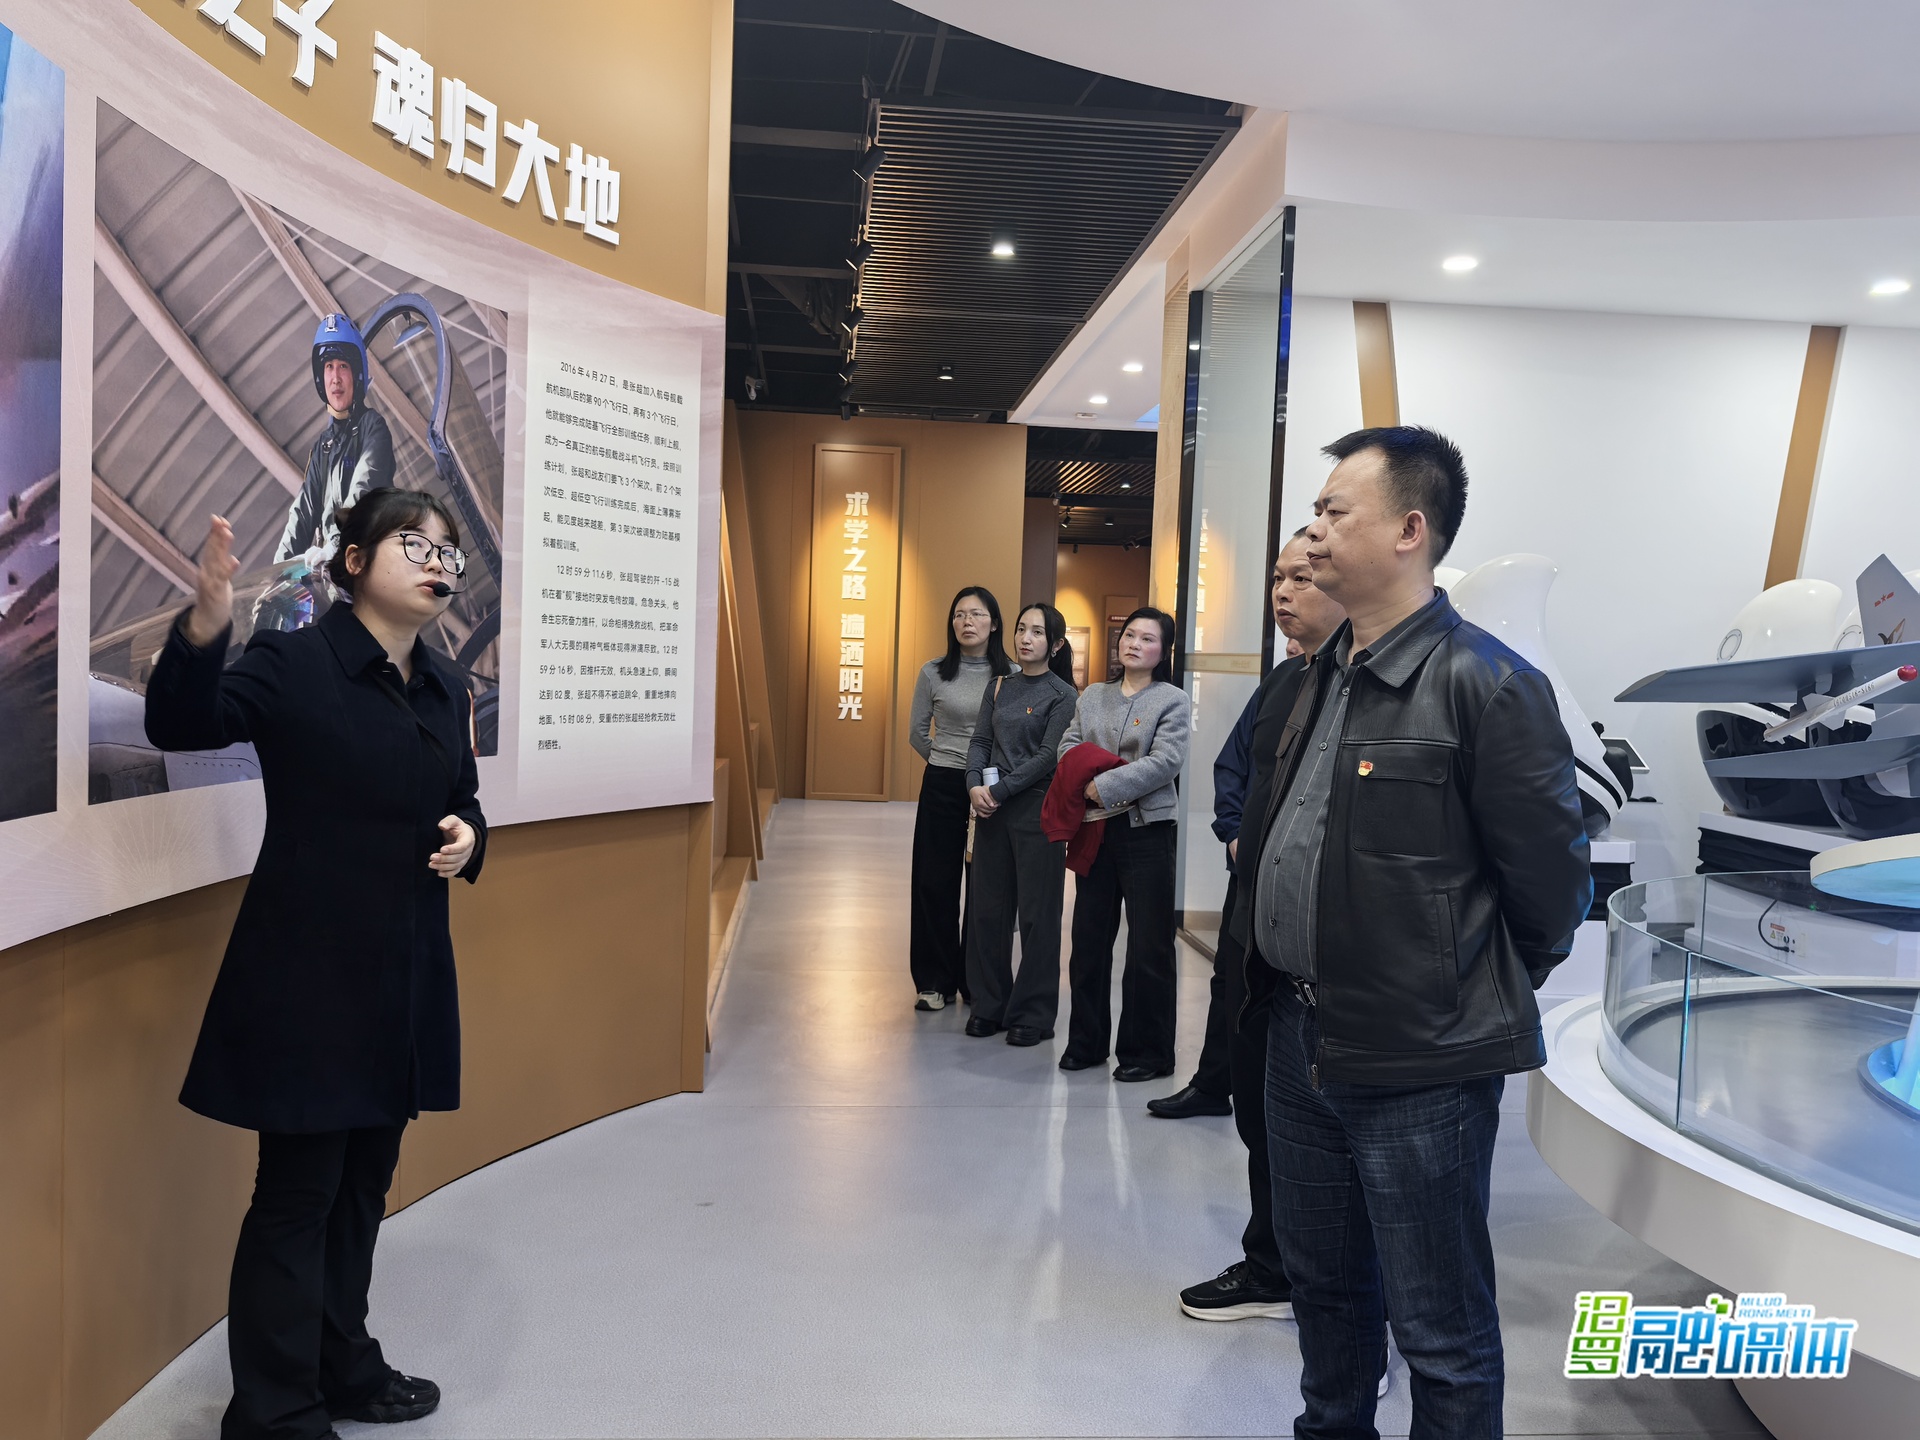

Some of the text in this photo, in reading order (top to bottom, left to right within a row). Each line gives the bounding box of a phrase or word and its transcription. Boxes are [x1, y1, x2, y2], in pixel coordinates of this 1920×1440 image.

[372, 31, 620, 246] 魂归大地
[838, 491, 869, 720] 求学之路 遍洒阳光
